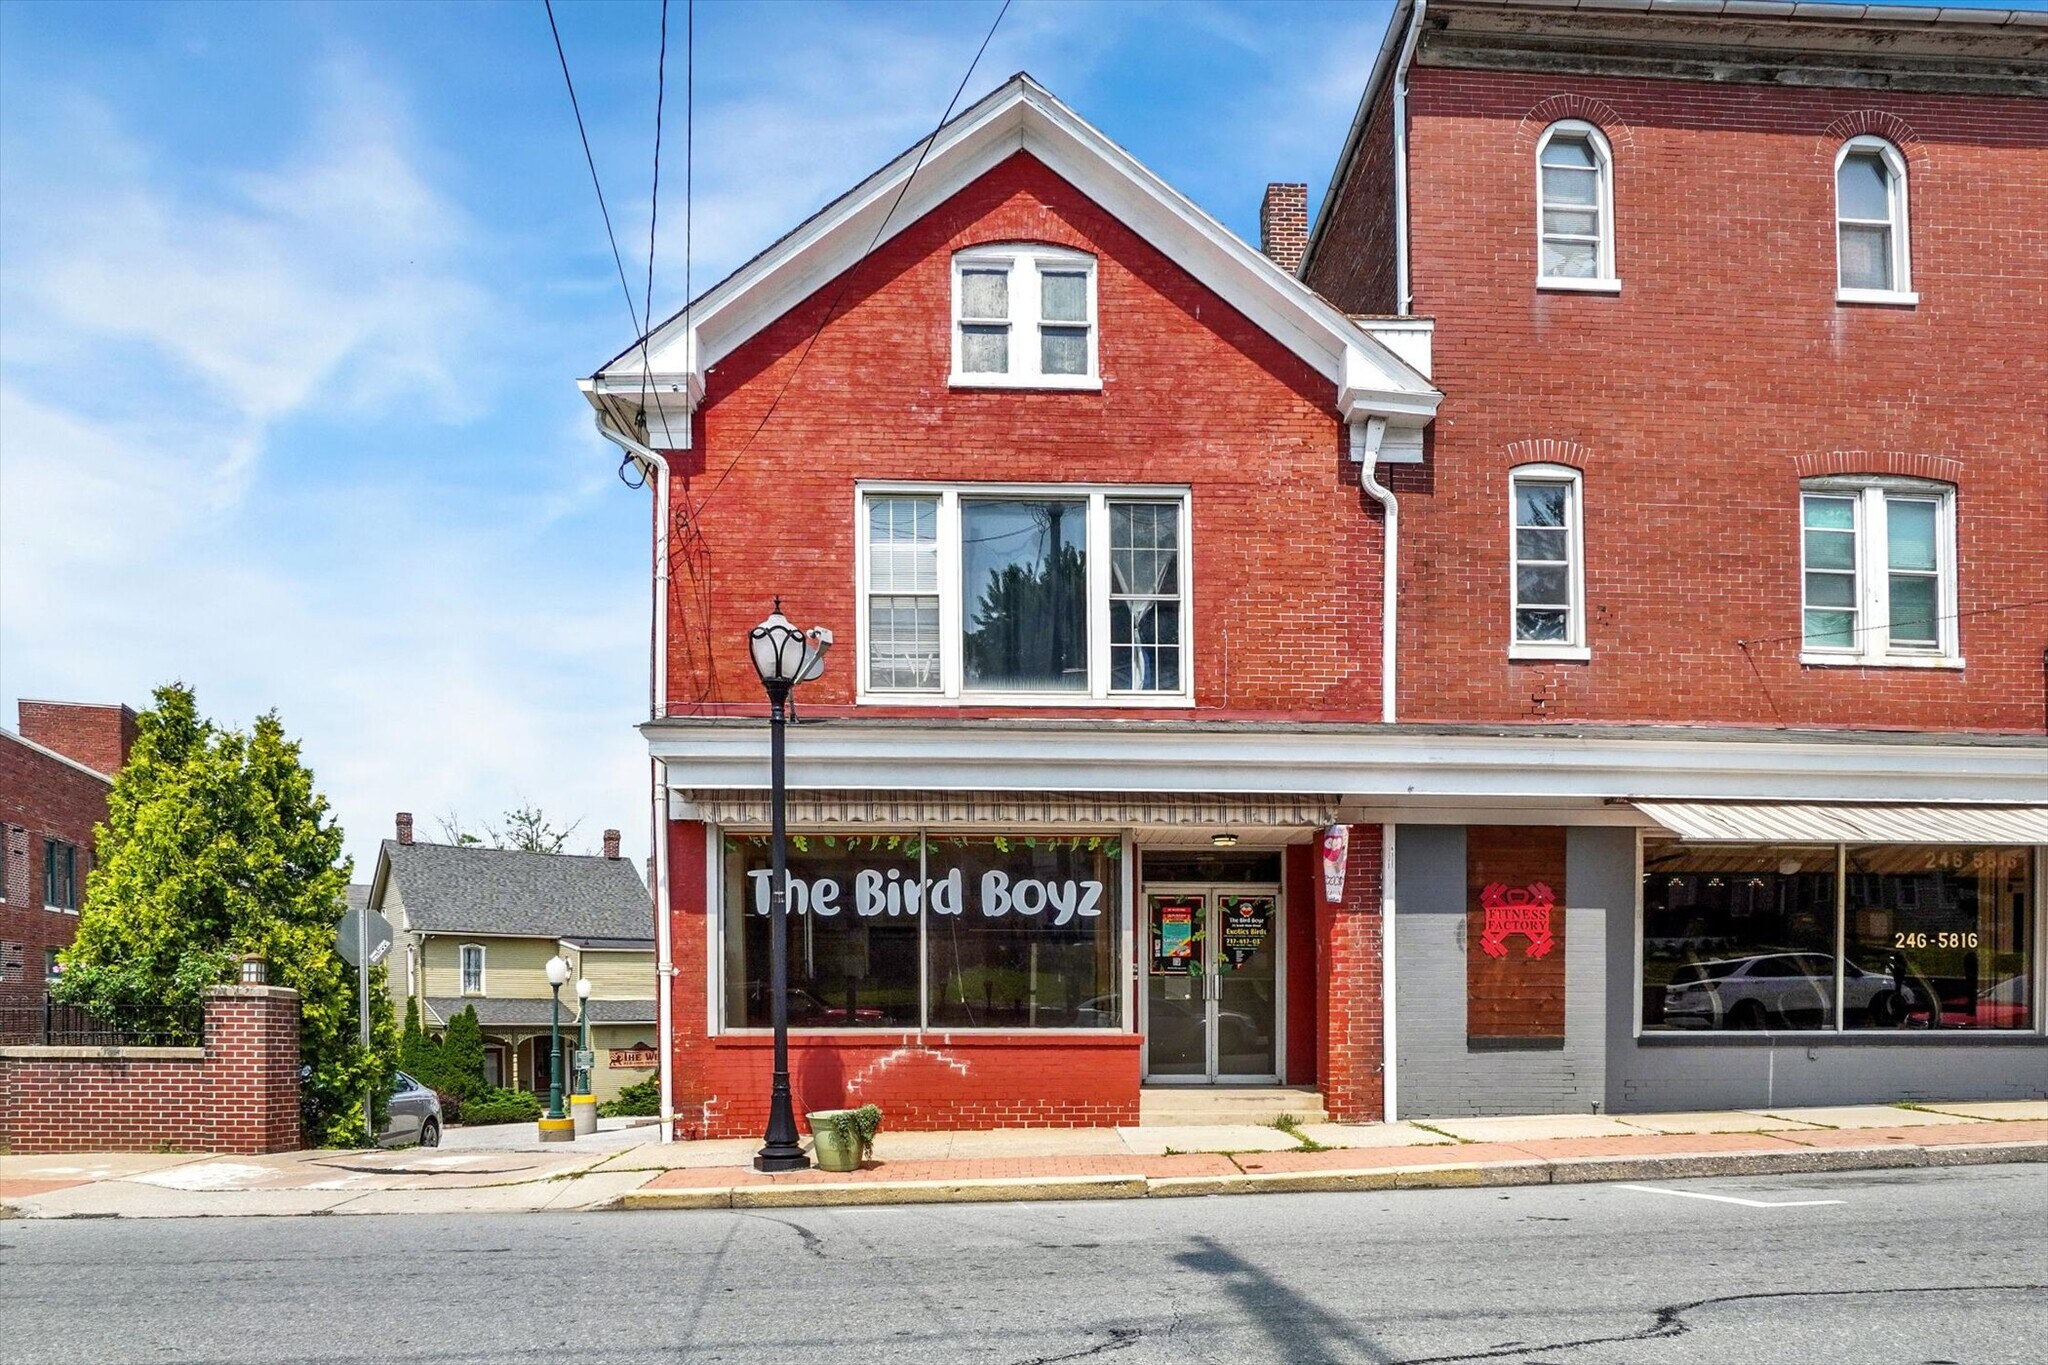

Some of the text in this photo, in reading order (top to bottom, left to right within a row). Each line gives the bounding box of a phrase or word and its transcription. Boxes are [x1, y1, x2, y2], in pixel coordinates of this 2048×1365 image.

[747, 867, 1104, 926] The Bird Boyz
[1489, 908, 1547, 921] FITNESS
[1487, 920, 1548, 931] FACTORY
[1894, 932, 1979, 950] 246-5816
[624, 1051, 641, 1062] THE
